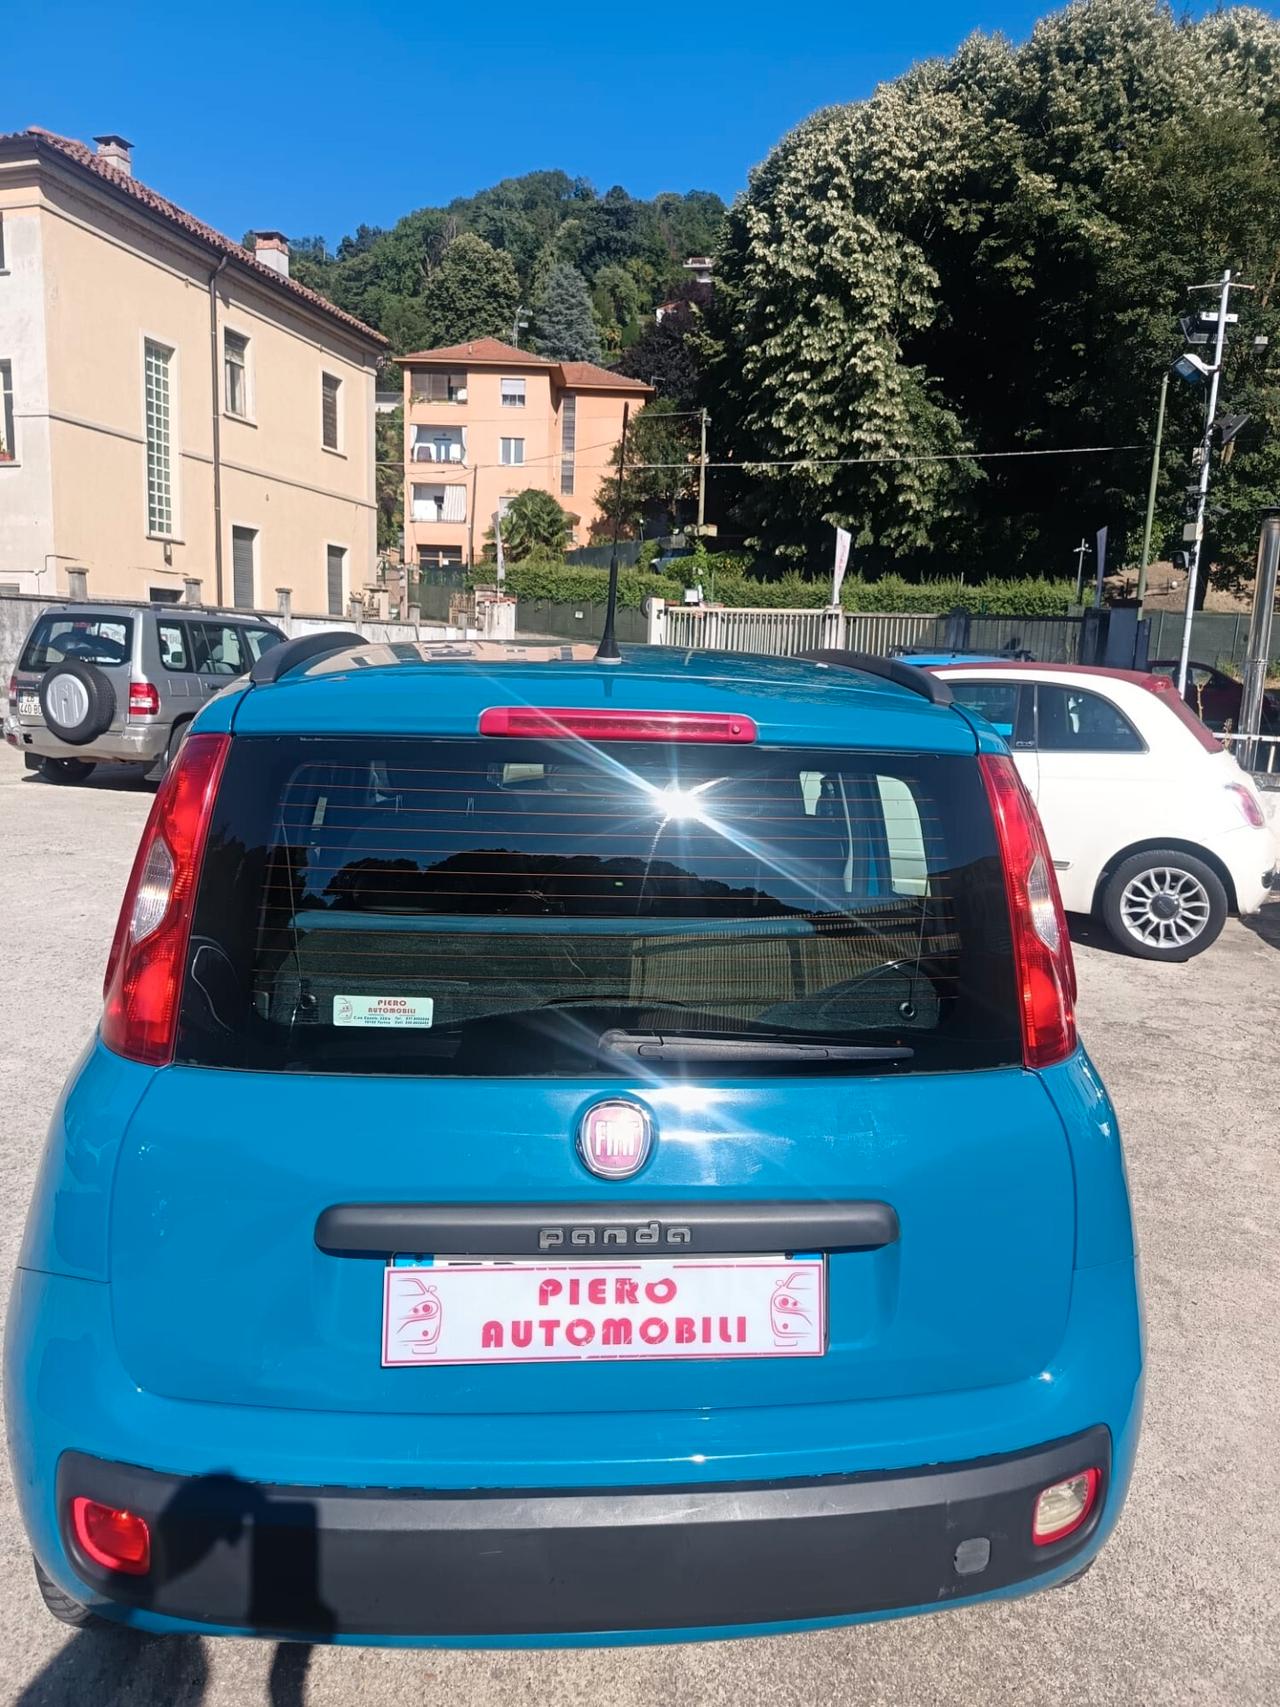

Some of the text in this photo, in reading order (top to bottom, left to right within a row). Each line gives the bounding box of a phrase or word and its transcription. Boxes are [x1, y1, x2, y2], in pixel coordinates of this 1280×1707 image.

[377, 999, 407, 1007] PIERO
[538, 1221, 692, 1249] panda
[537, 1277, 678, 1306] PIERO
[481, 1316, 748, 1348] AUTOMOBILI
